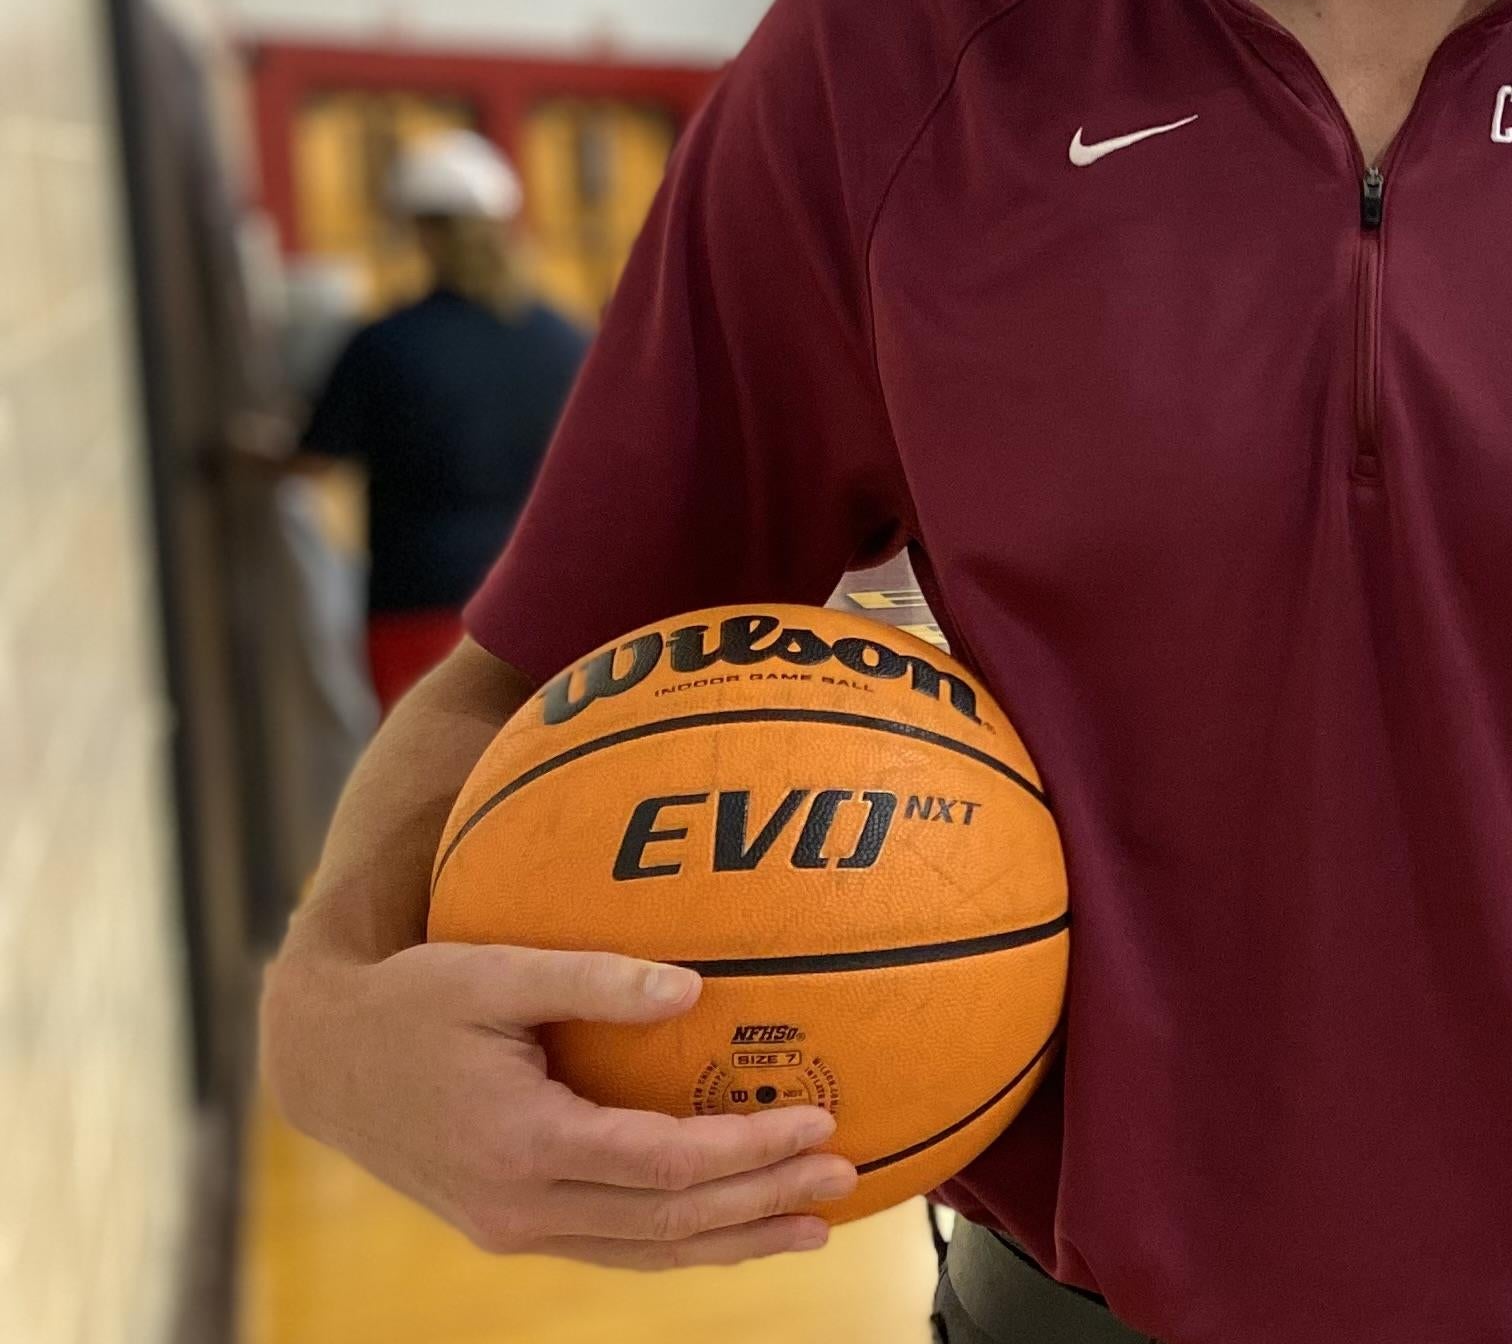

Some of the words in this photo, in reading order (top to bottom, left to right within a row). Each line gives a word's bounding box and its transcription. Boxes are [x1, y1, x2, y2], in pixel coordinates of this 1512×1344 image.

[541, 615, 983, 726] Wilson
[655, 674, 740, 697] INDOOR
[749, 672, 813, 681] GAME
[821, 675, 875, 693] BALL
[611, 788, 899, 882] EVO
[904, 794, 982, 826] NXT
[737, 1054, 779, 1065] SIZE
[785, 1053, 797, 1064] 7
